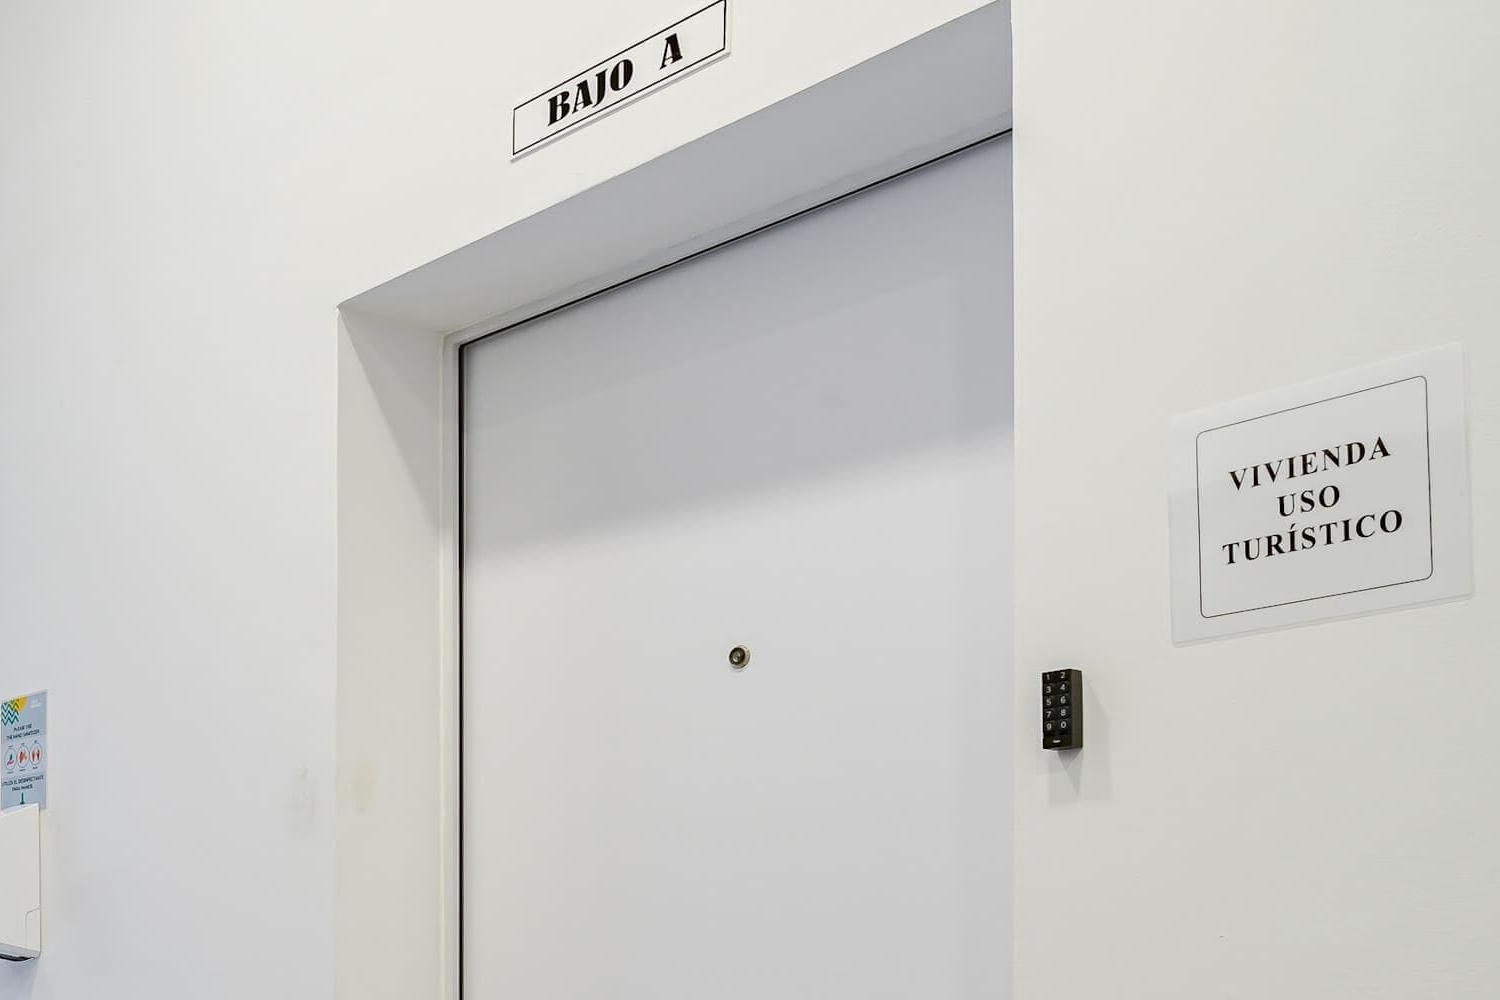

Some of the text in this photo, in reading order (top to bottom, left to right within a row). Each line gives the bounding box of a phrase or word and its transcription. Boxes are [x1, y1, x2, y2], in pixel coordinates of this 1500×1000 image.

[547, 33, 683, 127] BAJO A
[1227, 436, 1392, 491] VIVIENDA
[1275, 484, 1341, 518] USO
[1221, 508, 1403, 566] TURÍSTICO
[1045, 686, 1052, 694] 3
[1046, 695, 1066, 706] 5 6
[1045, 710, 1052, 718] 7
[1060, 721, 1067, 729] 0
